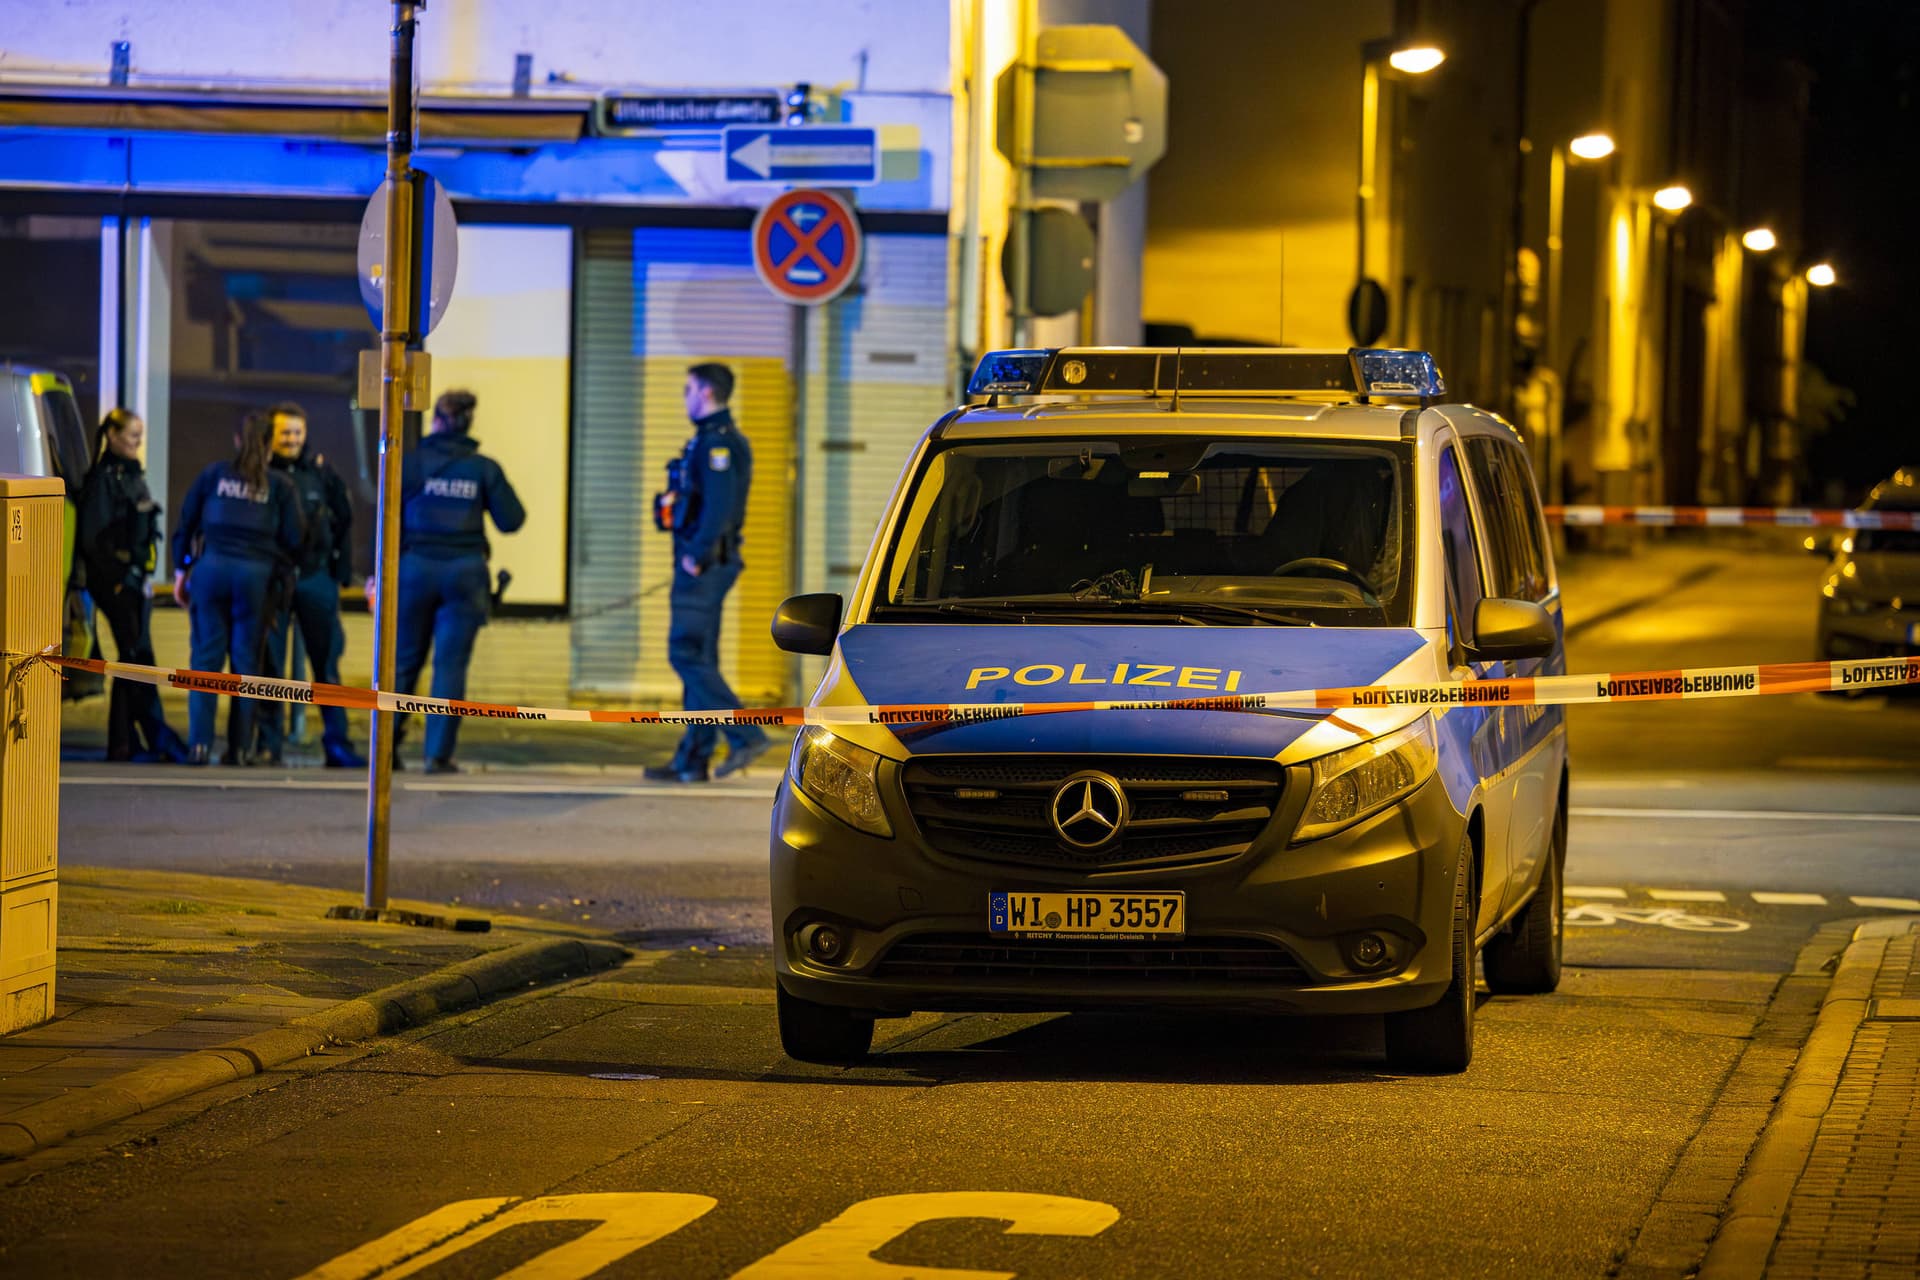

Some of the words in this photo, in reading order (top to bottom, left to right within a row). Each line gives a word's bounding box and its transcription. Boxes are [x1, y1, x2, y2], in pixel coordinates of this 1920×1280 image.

[424, 478, 478, 499] POLIZEI
[12, 509, 21, 524] VS
[12, 525, 22, 541] 172
[964, 663, 1242, 692] POLIZEI
[995, 915, 1004, 925] D
[1010, 896, 1043, 926] WI
[1066, 897, 1102, 928] HP
[1109, 898, 1179, 929] 3557
